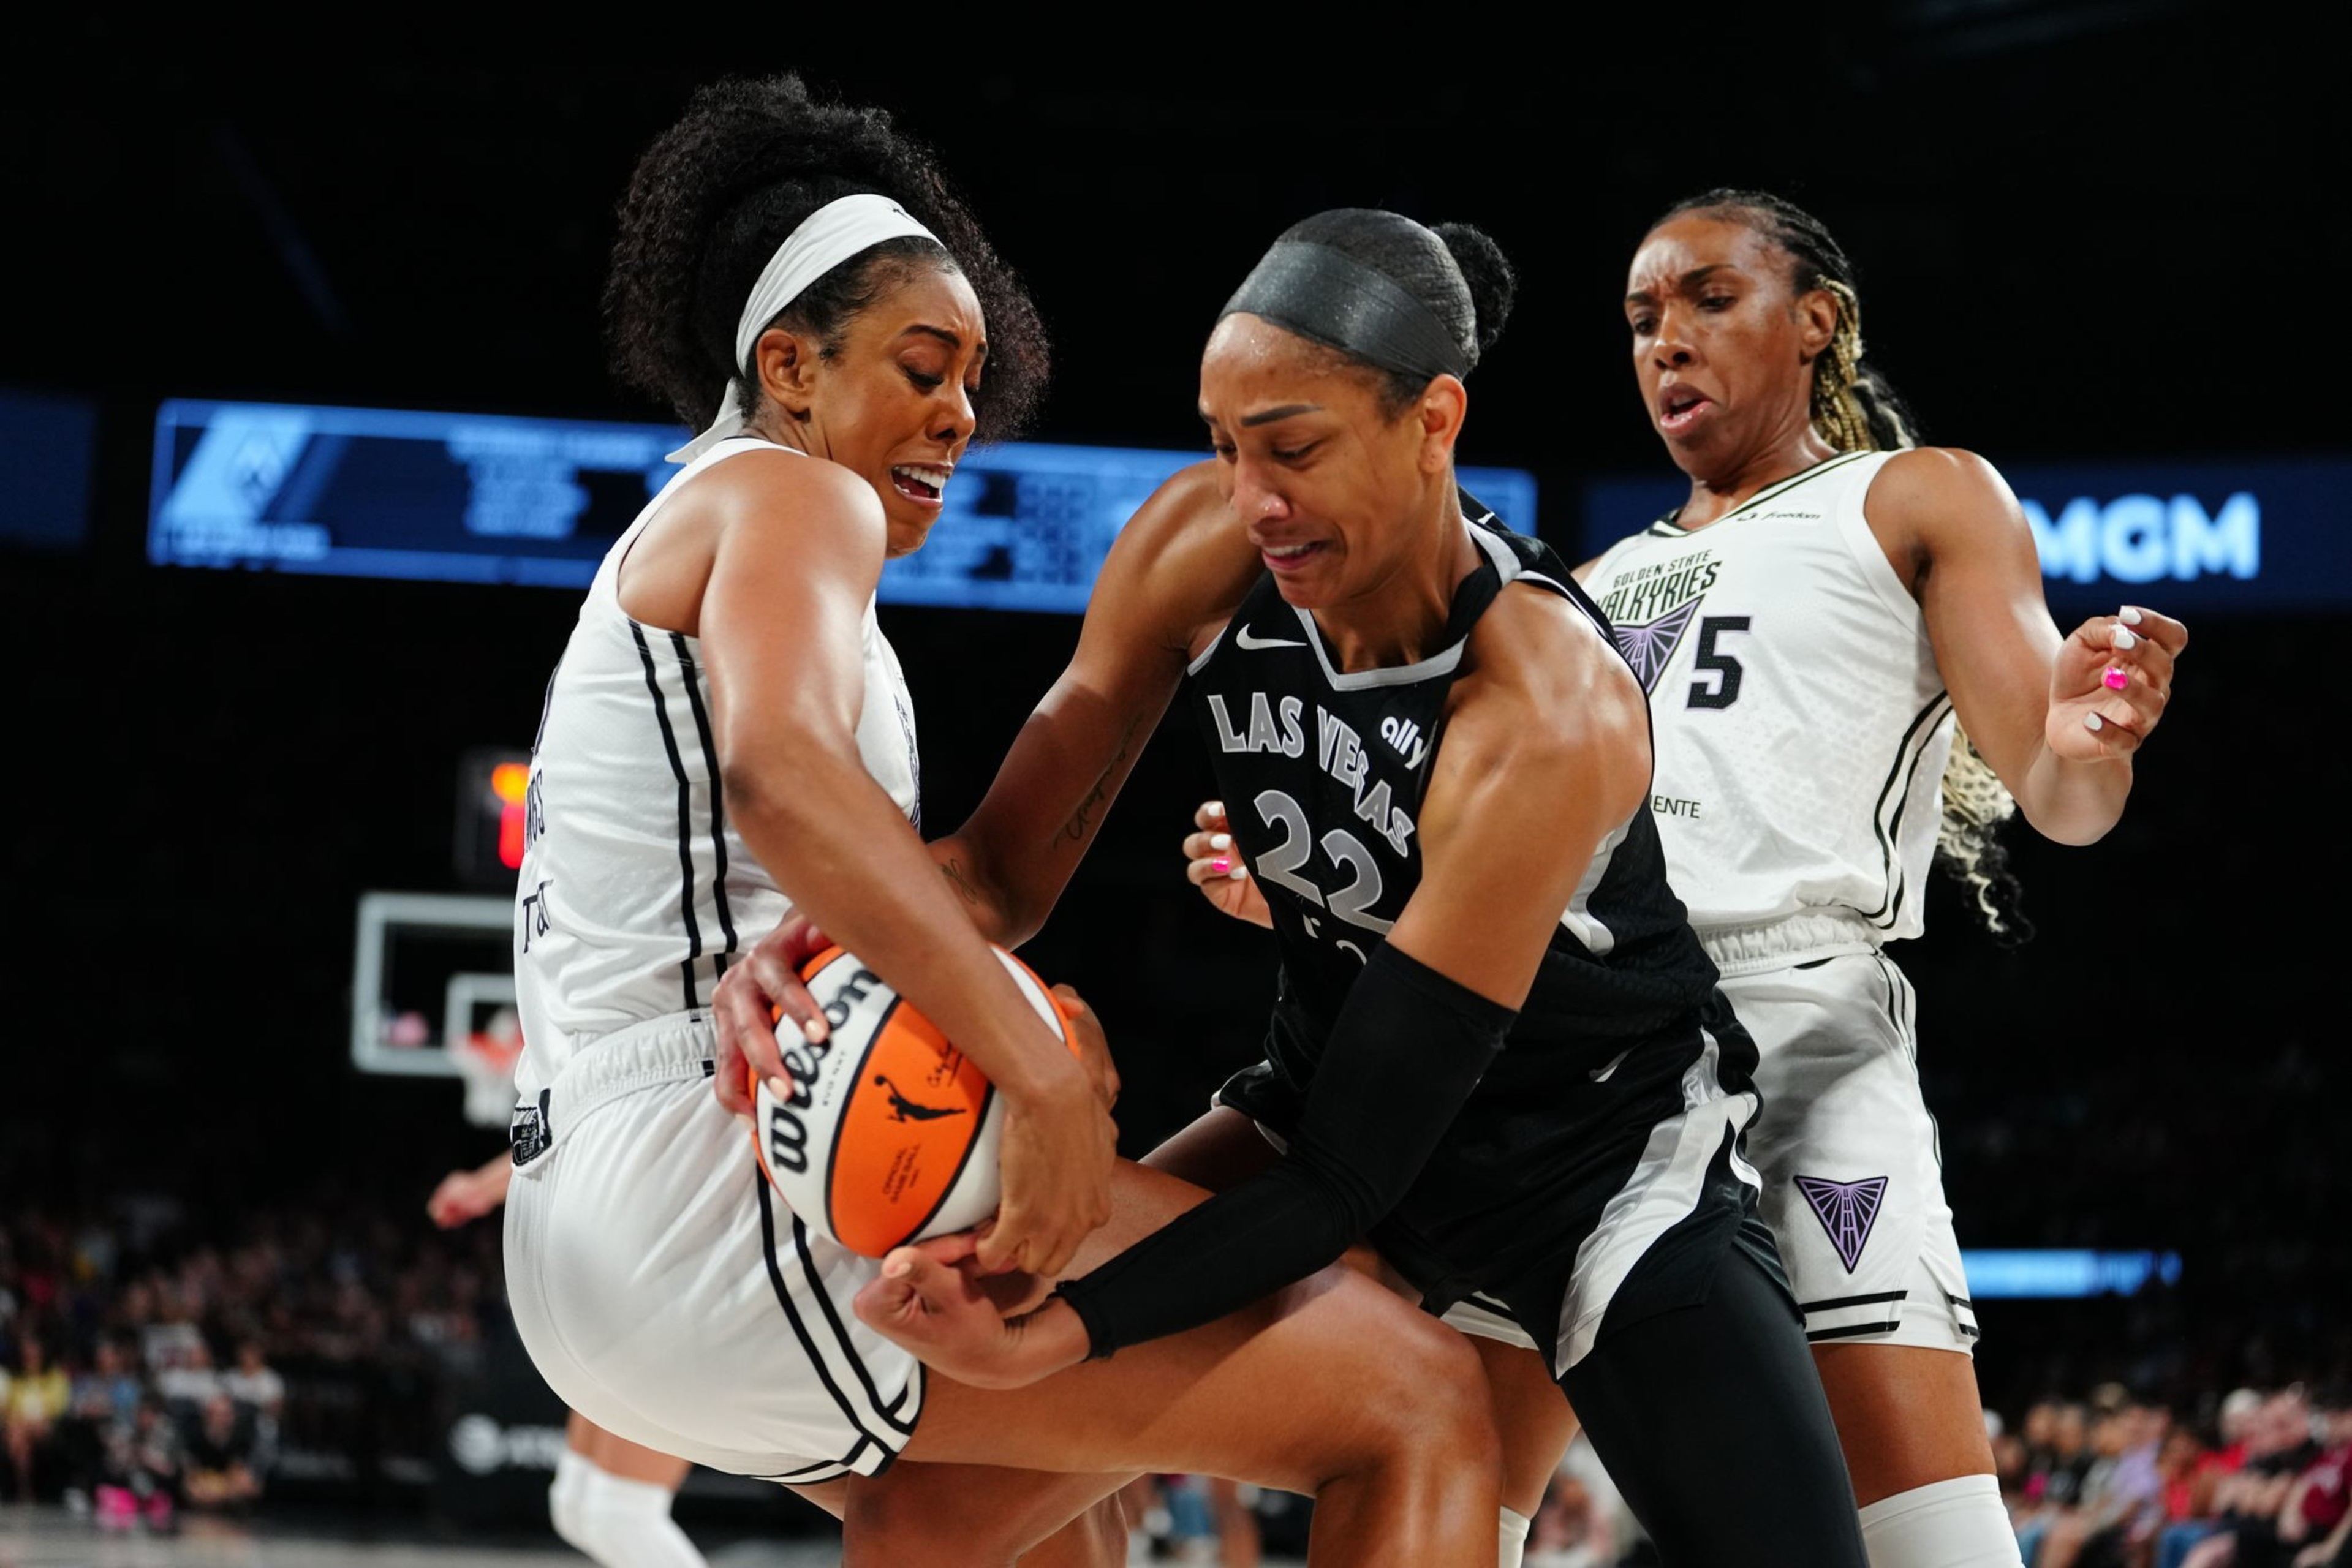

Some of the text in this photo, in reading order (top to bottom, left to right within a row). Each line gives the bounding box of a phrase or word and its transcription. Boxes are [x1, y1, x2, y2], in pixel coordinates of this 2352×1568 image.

[1597, 560, 1723, 622] VALKYRIES
[1613, 549, 1713, 589] GOLDEN STATE
[1684, 616, 1753, 712] 5
[1207, 692, 1305, 758] LAS
[1381, 716, 1427, 770] ally
[1254, 788, 1395, 935] 22
